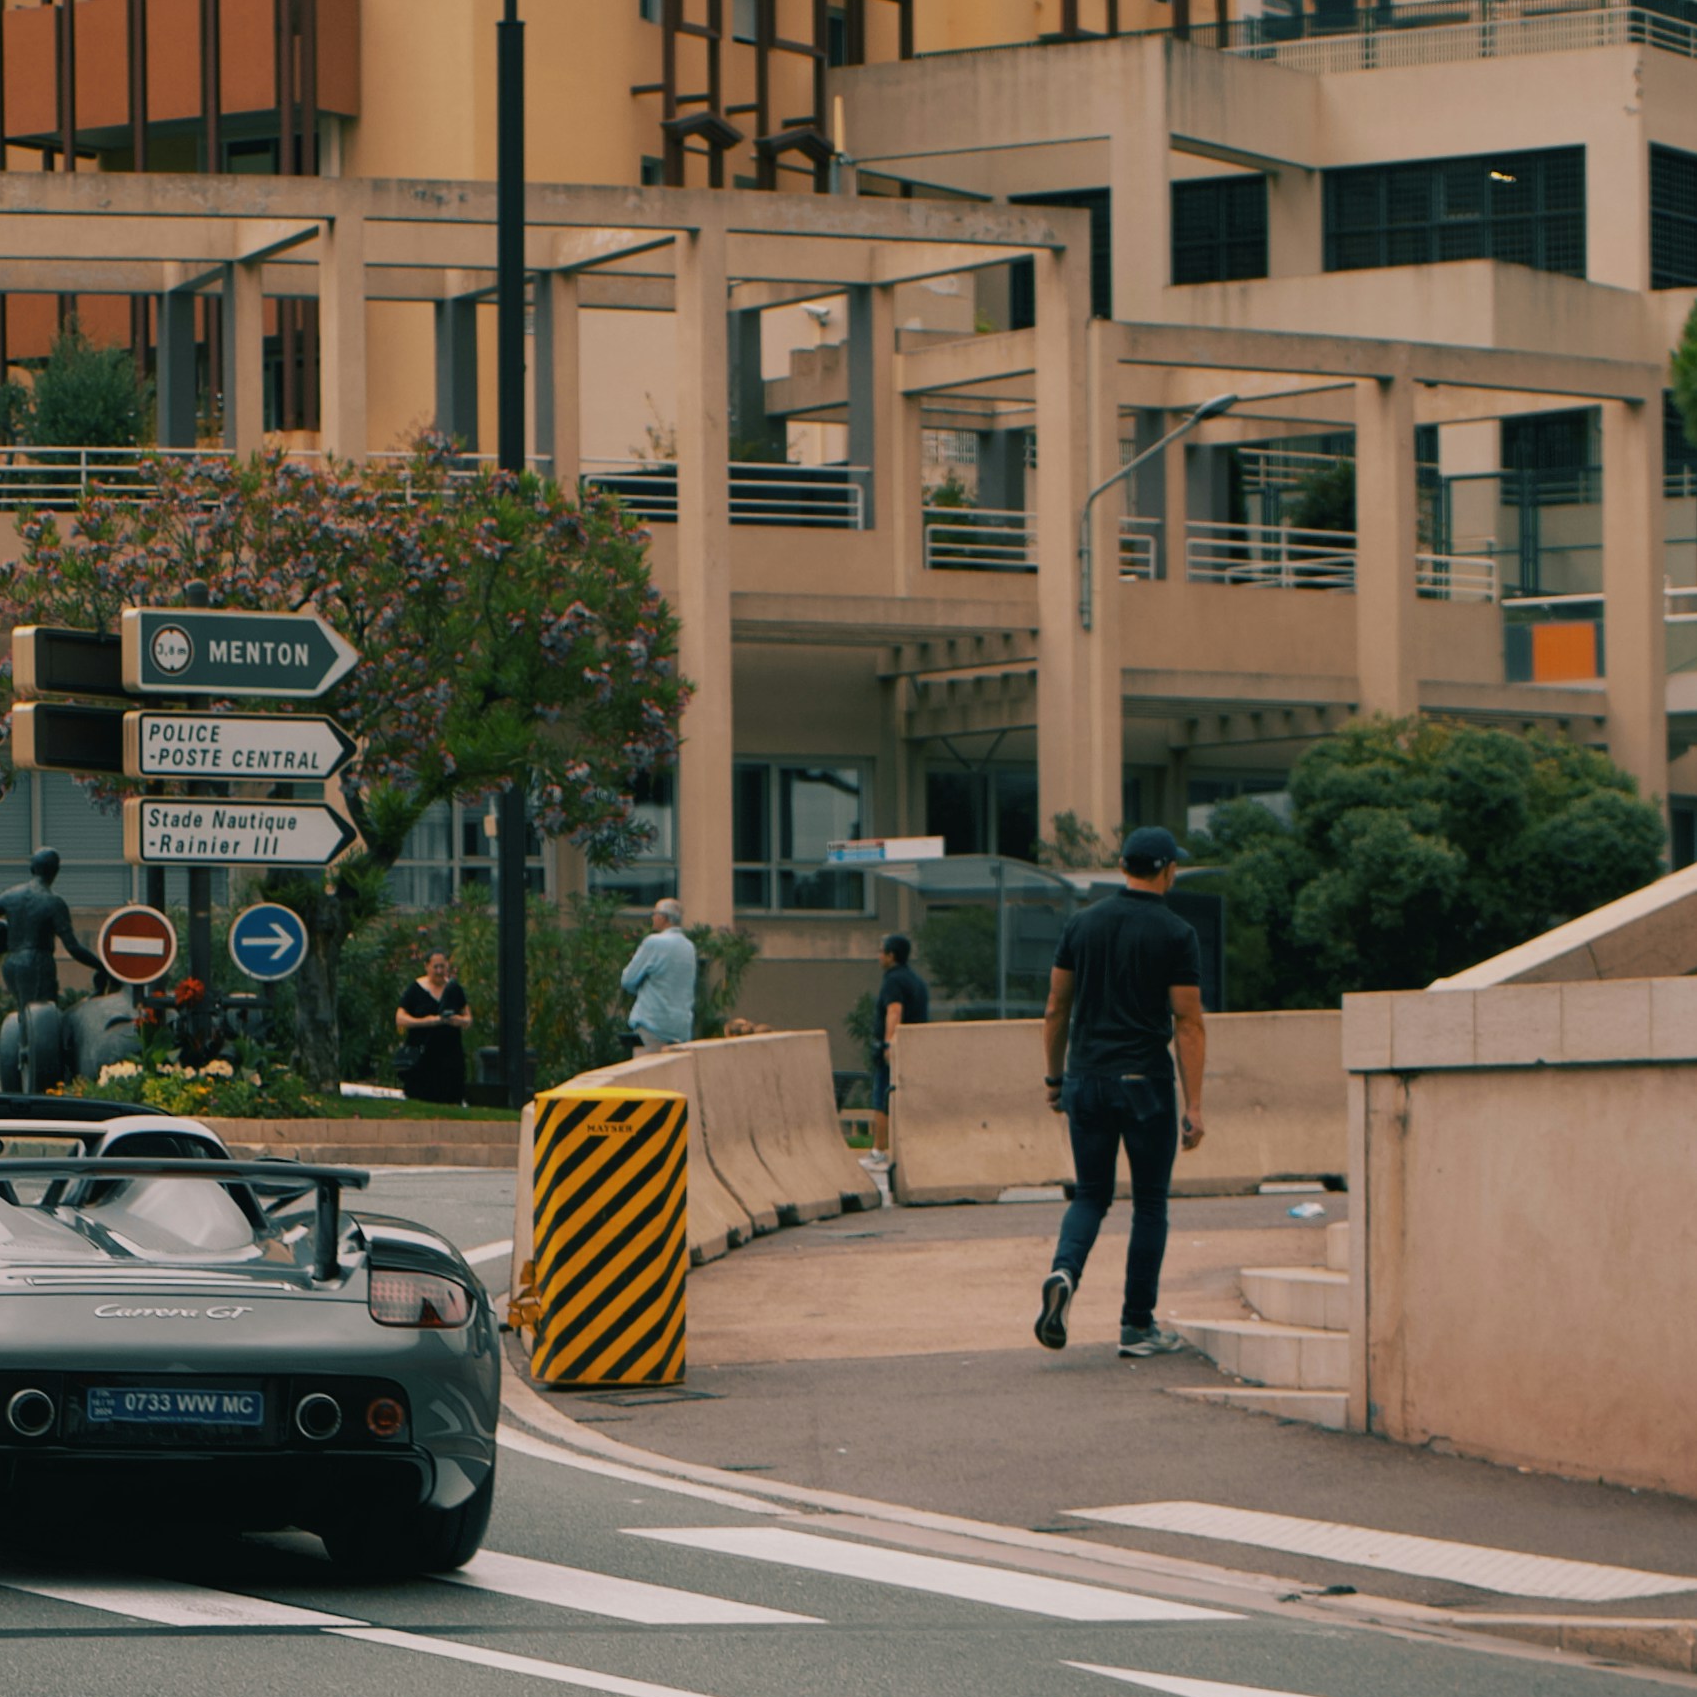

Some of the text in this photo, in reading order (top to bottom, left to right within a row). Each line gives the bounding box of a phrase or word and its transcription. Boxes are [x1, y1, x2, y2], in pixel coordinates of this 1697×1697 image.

[208, 640, 310, 667] MENTON
[148, 723, 222, 744] POLICE
[231, 750, 320, 770] CENTRAL
[148, 808, 298, 835] Stade Nautique
[253, 836, 279, 856] III
[93, 1303, 254, 1320] Carrera GT
[124, 1393, 254, 1415] 0733 WW MC
